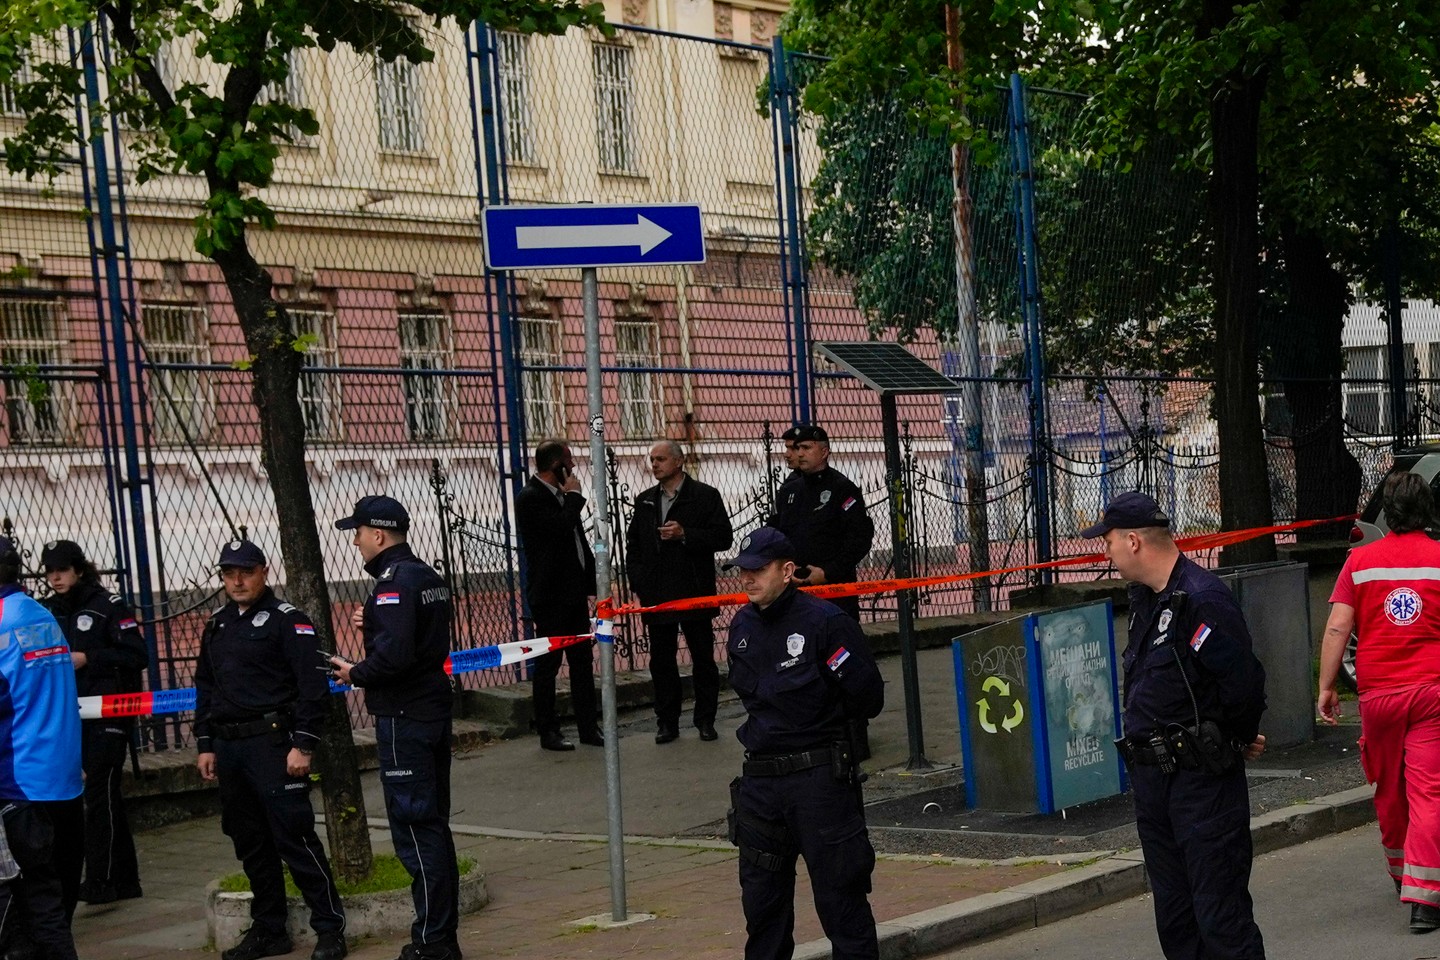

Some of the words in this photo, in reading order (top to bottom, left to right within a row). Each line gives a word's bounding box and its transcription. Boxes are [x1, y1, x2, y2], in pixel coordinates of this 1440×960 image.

[370, 518, 397, 527] ПОЛИЦИЈА
[1064, 750, 1104, 771] RECYCLATE
[385, 769, 413, 777] ПОЛИЦИЈА
